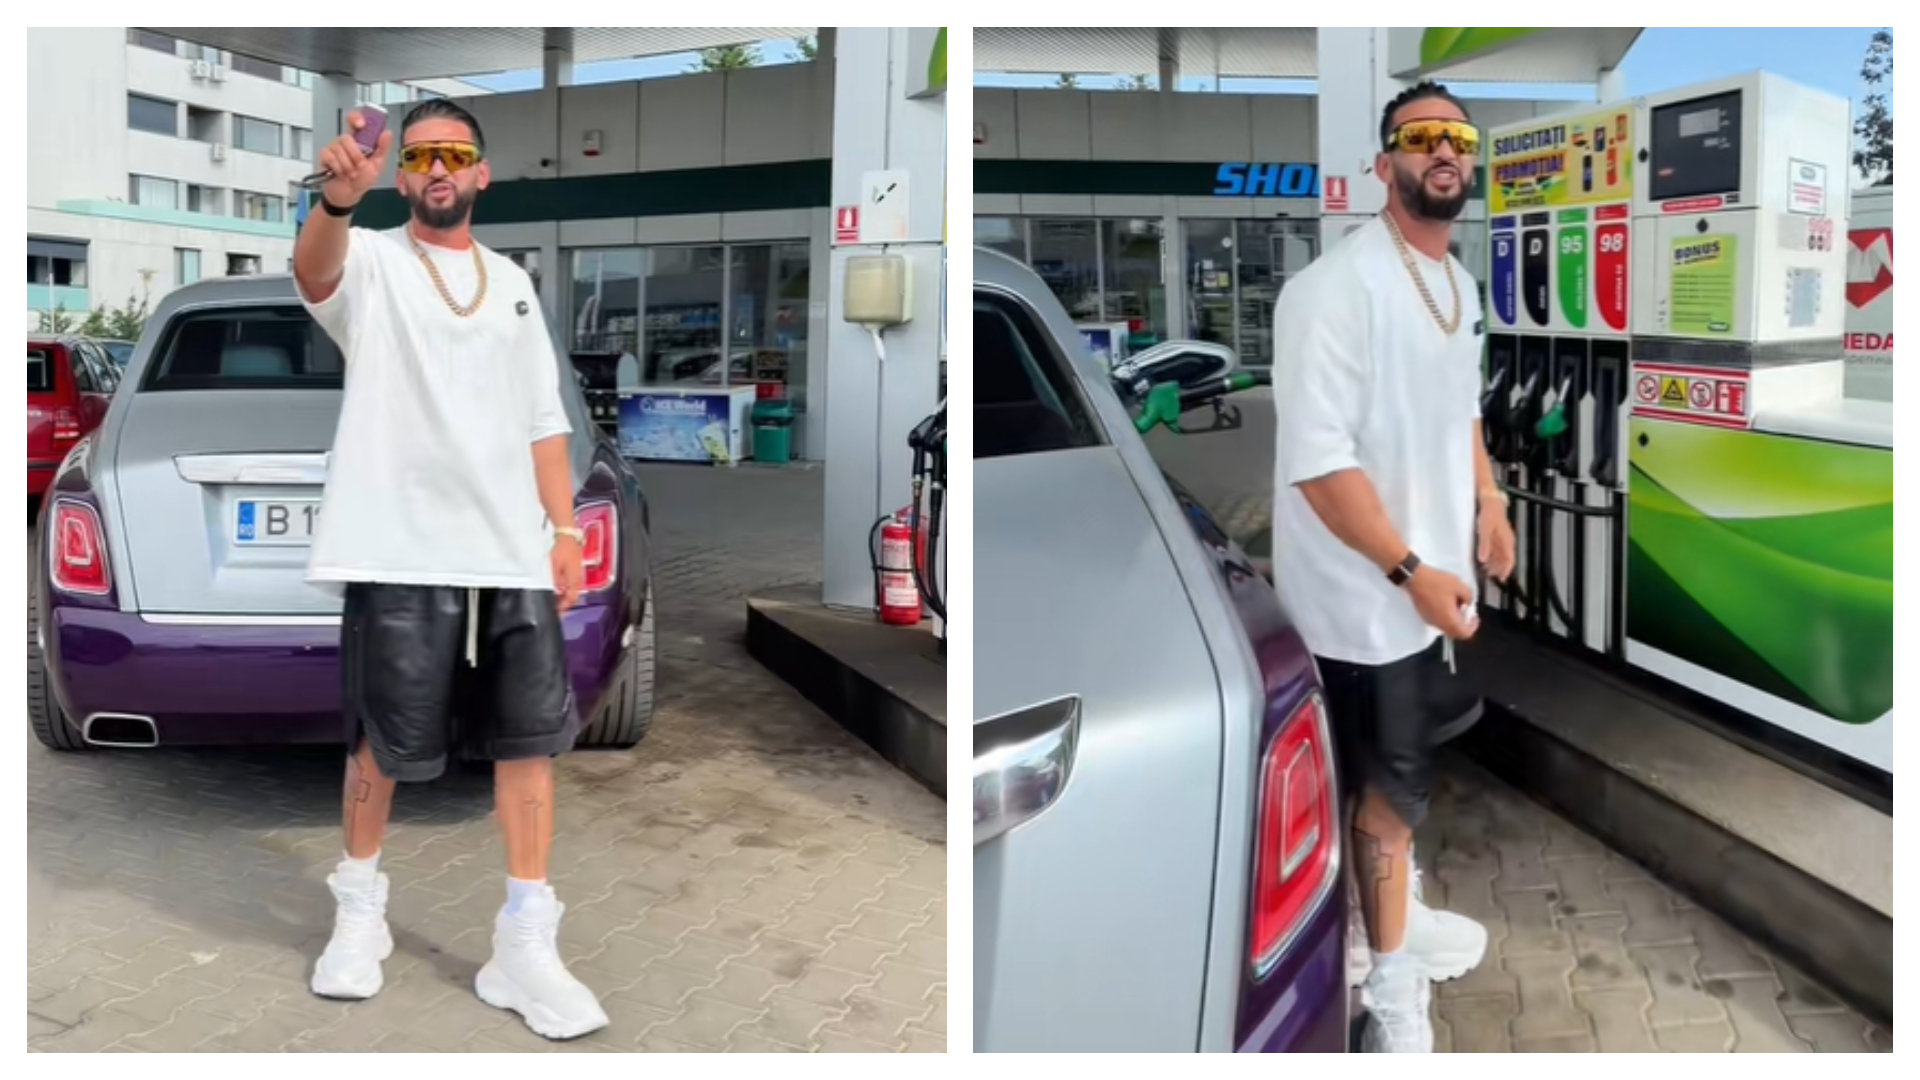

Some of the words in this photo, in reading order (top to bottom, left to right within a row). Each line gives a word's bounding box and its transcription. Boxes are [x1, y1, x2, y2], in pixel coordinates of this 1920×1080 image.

[1213, 163, 1319, 196] SHO
[1497, 240, 1509, 257] D
[1529, 238, 1543, 256] D
[1561, 235, 1583, 254] 95
[1600, 233, 1624, 253] 98
[266, 505, 290, 535] B
[303, 505, 321, 535] 1
